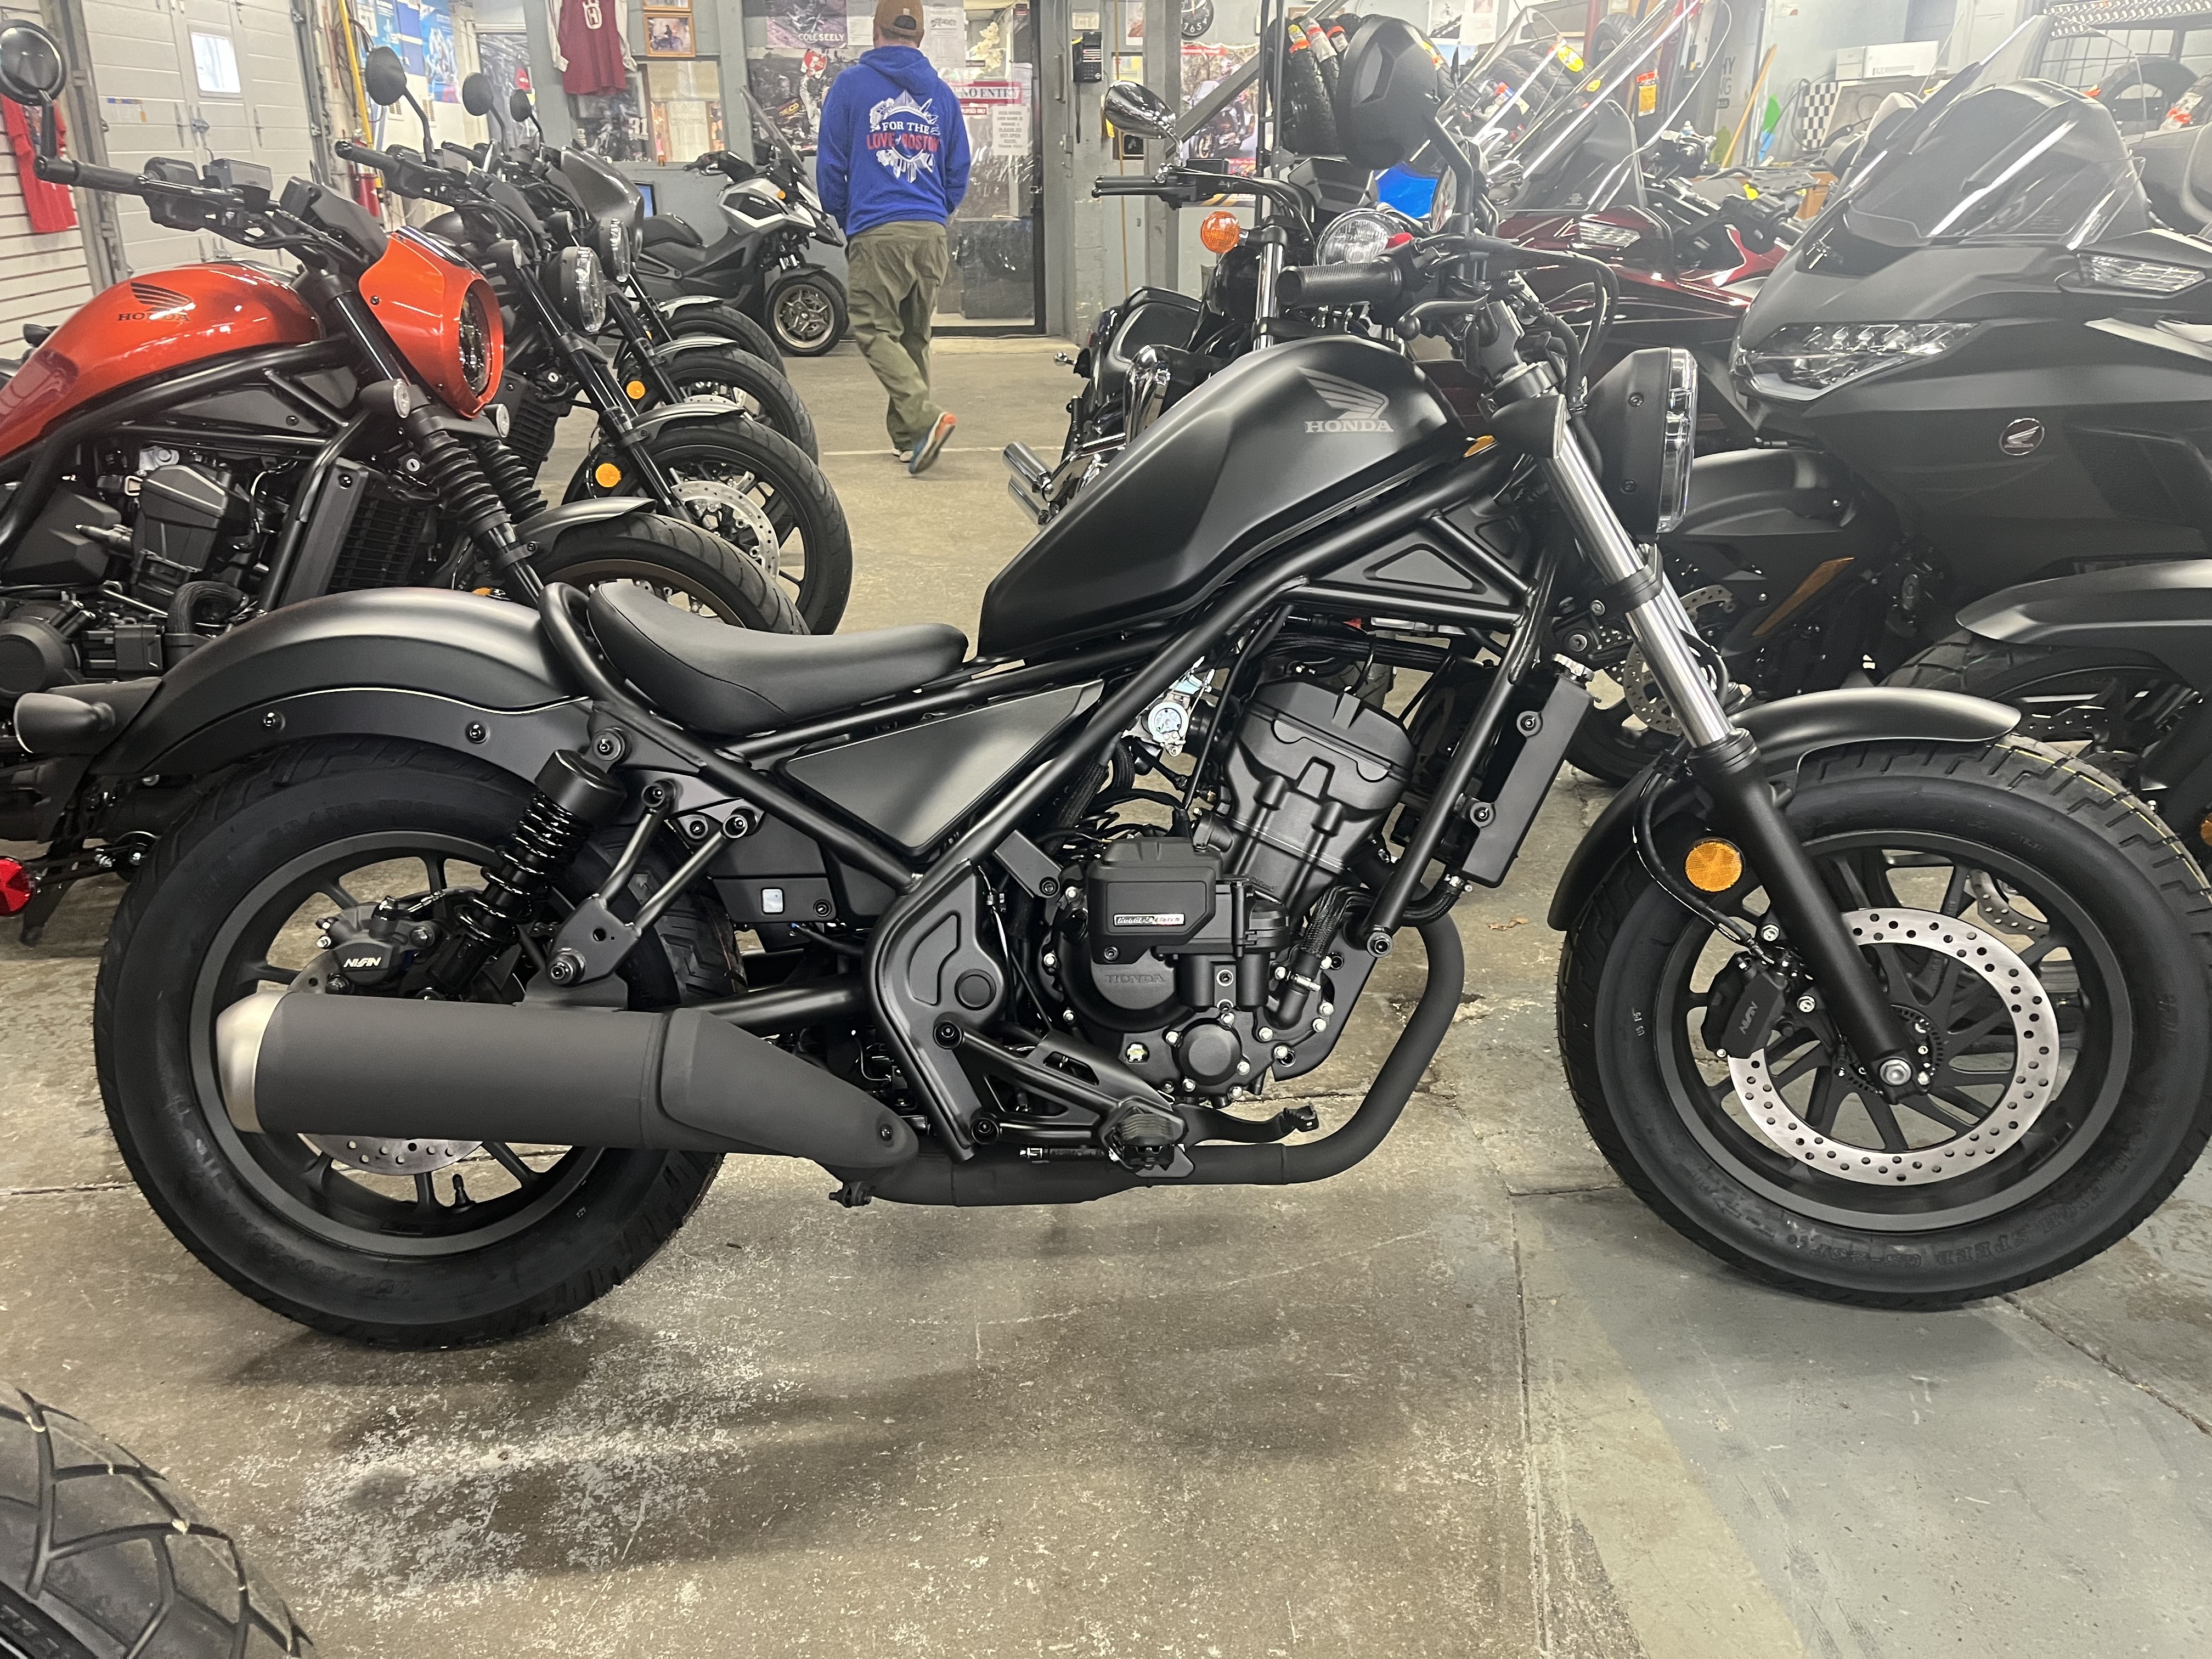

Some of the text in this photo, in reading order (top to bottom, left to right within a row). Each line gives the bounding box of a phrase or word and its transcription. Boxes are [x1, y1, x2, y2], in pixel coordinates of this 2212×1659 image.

[1205, 9, 1210, 17] 3
[1189, 25, 1195, 33] 6
[1197, 22, 1202, 31] 5
[882, 121, 929, 134] FOR THE
[866, 132, 896, 150] LOVE
[118, 312, 190, 321] HODA
[1305, 419, 1394, 433] HONDA
[1105, 974, 1165, 984] HONDA
